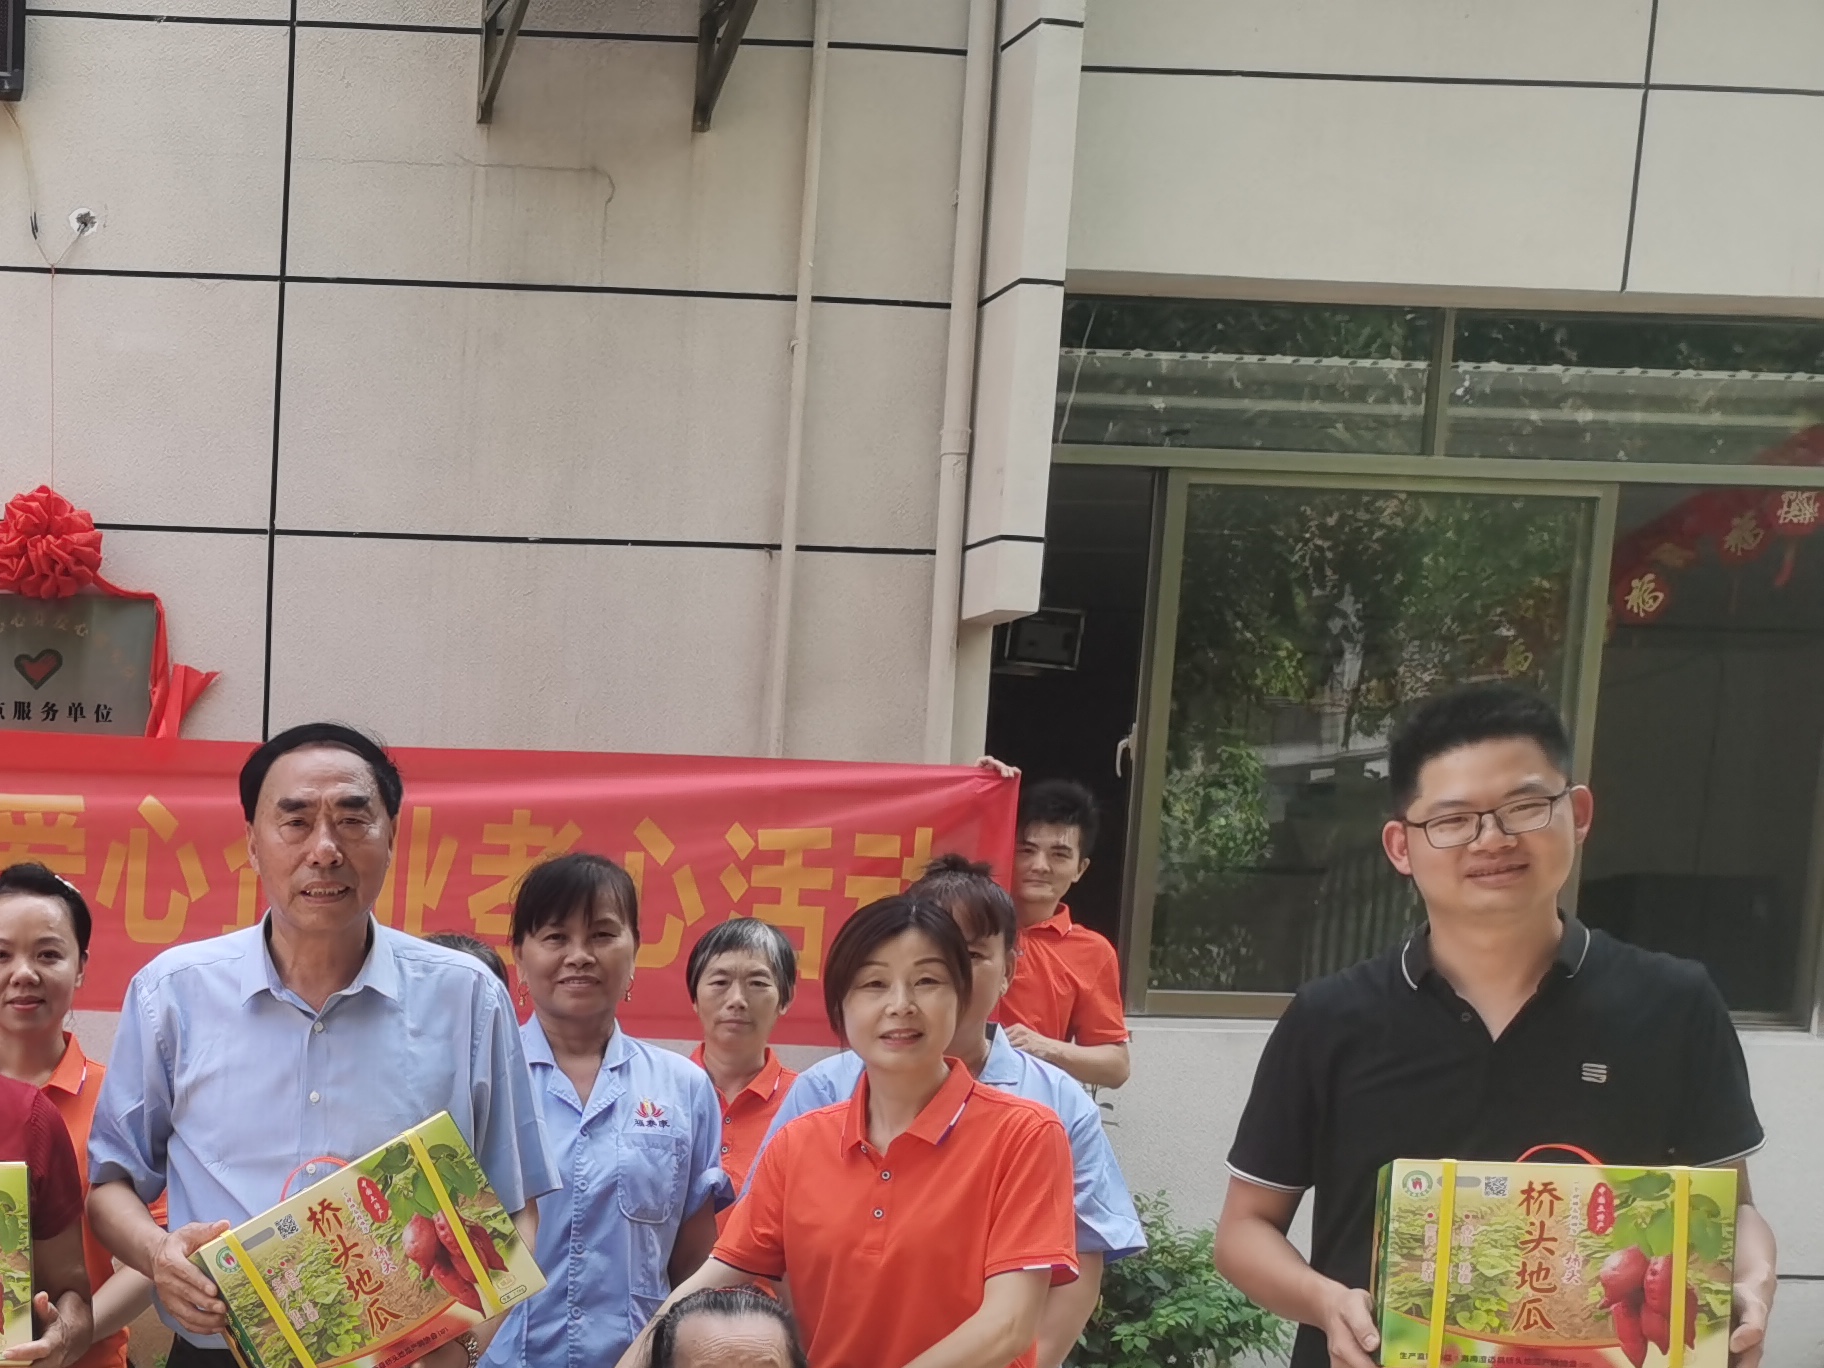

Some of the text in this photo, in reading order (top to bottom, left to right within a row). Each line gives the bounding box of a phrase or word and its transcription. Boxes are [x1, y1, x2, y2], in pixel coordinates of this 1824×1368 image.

[303, 1195, 403, 1335] 桥头地瓜
[1511, 1180, 1564, 1333] 桥头地瓜
